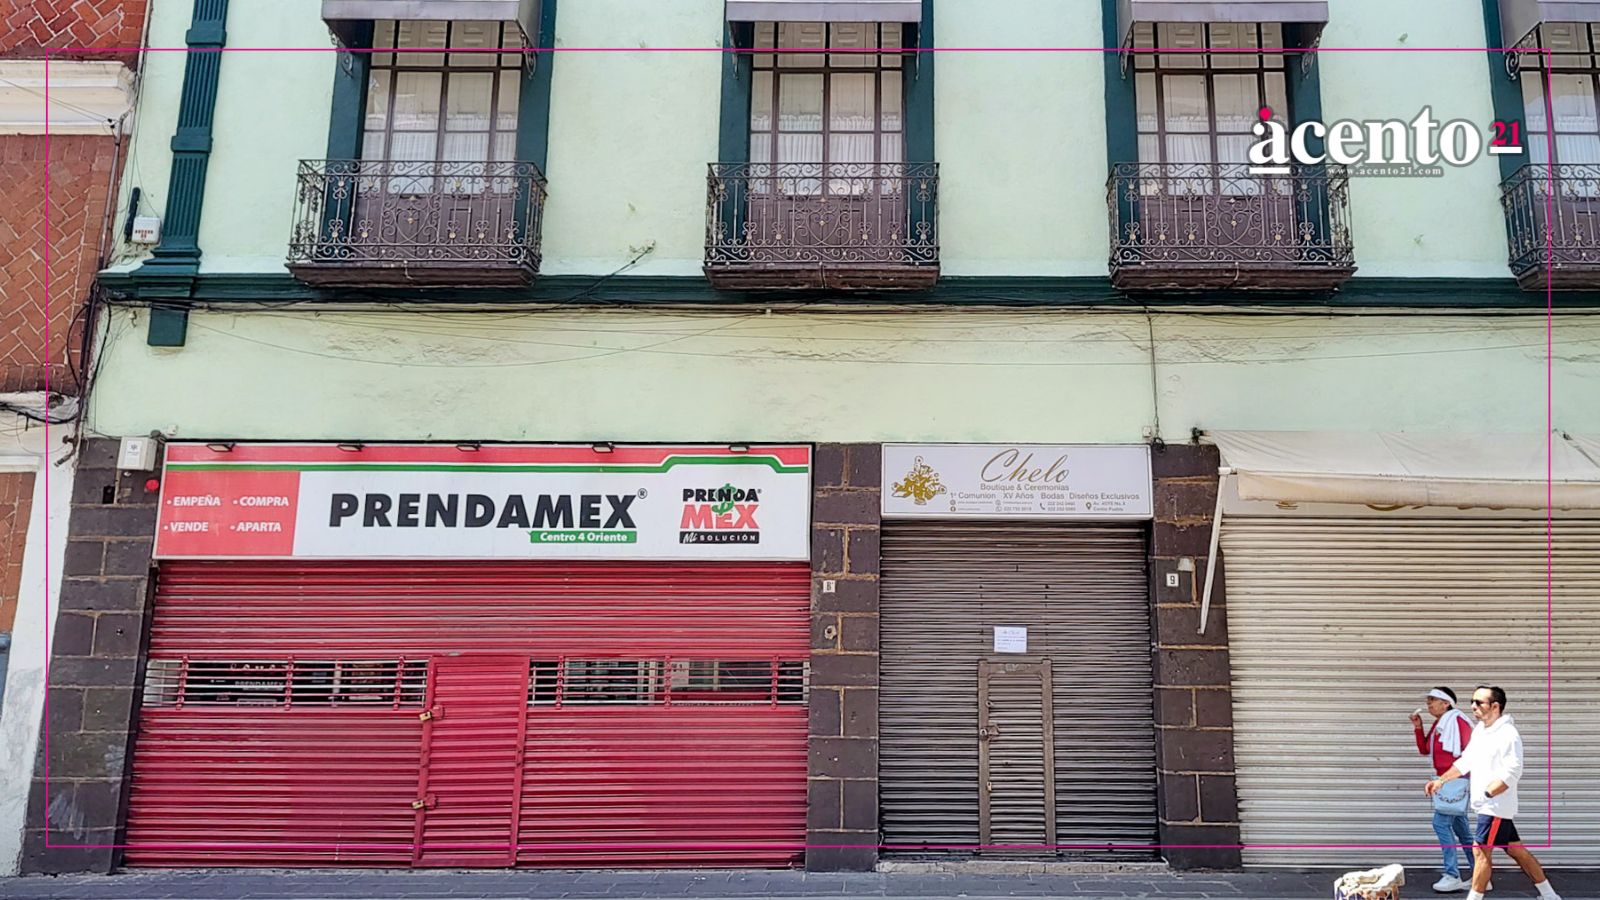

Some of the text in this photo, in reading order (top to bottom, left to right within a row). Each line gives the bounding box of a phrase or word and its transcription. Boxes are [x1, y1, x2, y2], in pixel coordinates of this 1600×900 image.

[981, 448, 1070, 483] Chelo
[980, 484, 1015, 493] Boutique
[173, 494, 289, 507] EMPEÑA COMPRA
[1069, 492, 1099, 500] Diseños
[1101, 492, 1140, 500] Exclusivos
[680, 504, 759, 529] MEX
[170, 522, 281, 532] VENDE APARTA
[540, 532, 628, 542] Centro 4 Oriente
[700, 533, 756, 541] SOLUCIÓN
